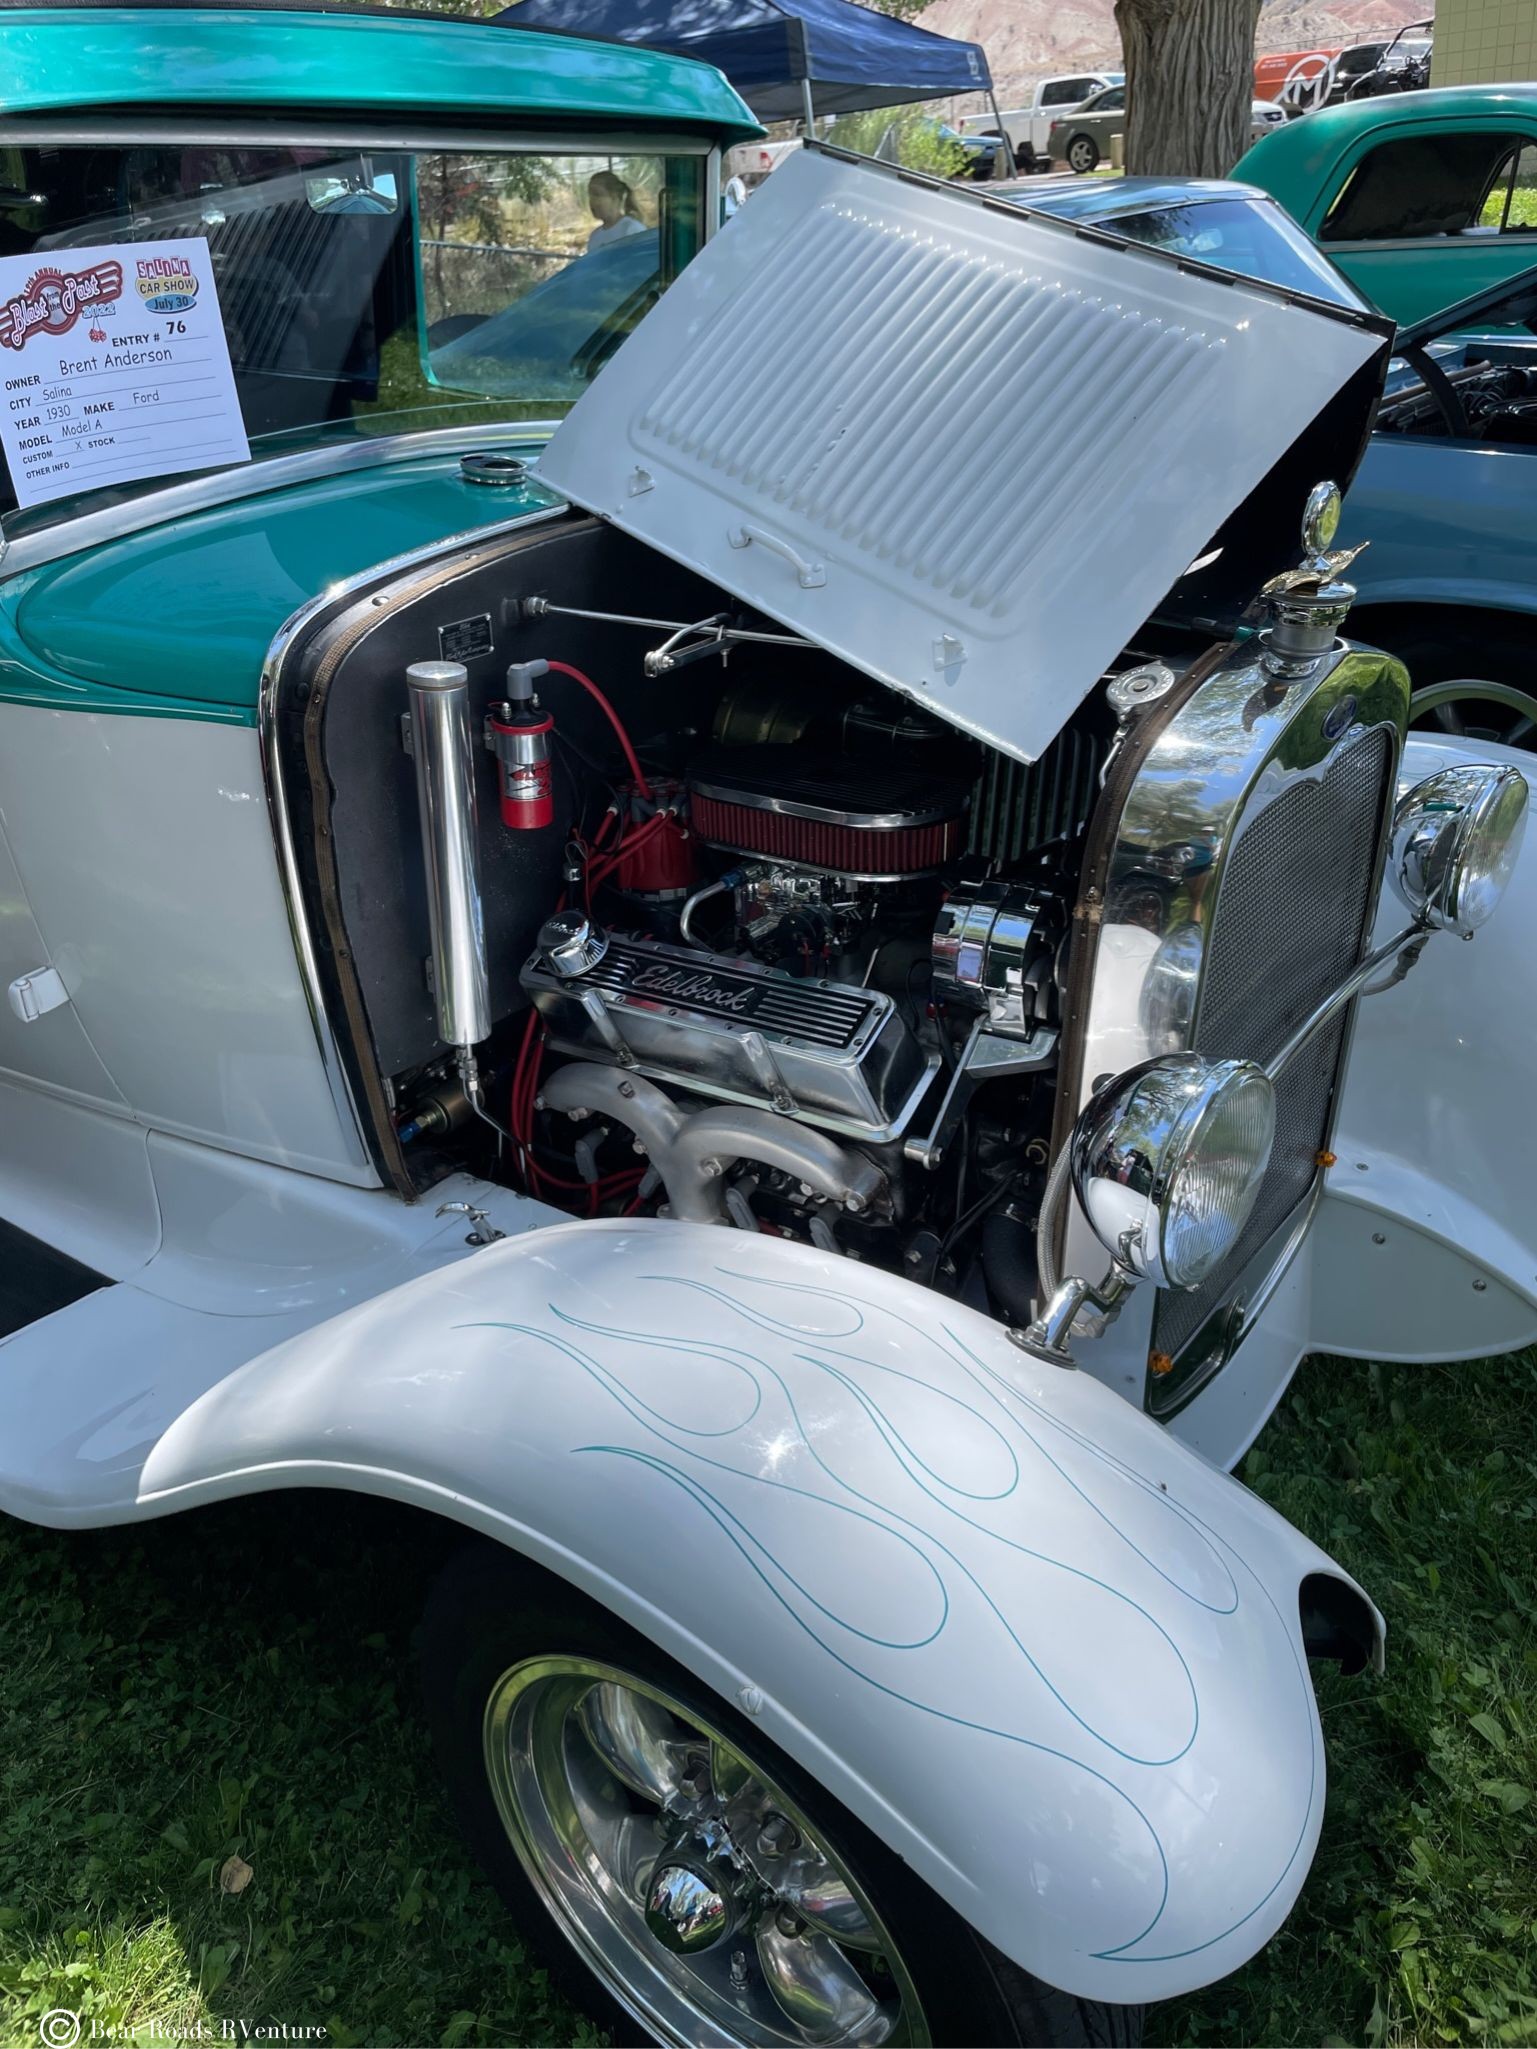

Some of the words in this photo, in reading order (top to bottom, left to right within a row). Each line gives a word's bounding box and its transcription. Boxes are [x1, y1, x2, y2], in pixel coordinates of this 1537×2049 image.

[35, 267, 62, 279] ANNUAL
[137, 258, 190, 279] SALINA
[46, 291, 60, 301] from
[62, 275, 100, 314] Past
[140, 282, 160, 294] CAR
[164, 280, 194, 292] SHOW
[49, 303, 60, 312] the
[82, 303, 116, 319] 2022
[154, 298, 173, 310] July
[176, 297, 189, 307] 30
[10, 298, 48, 346] Blast
[112, 334, 149, 347] ENTRY
[154, 333, 160, 343] #
[166, 320, 186, 335] 76
[5, 374, 41, 391] OWNER
[60, 356, 98, 376] Brent
[104, 349, 173, 368] Anderson
[9, 397, 31, 411] CITY
[42, 386, 72, 401] Salina
[14, 416, 41, 431] YEAR
[46, 405, 71, 420] 1930
[83, 402, 115, 416] MAKE
[133, 390, 160, 404] Ford
[19, 434, 53, 451] MODEL
[62, 420, 91, 437] Model
[95, 419, 103, 430] A
[22, 451, 53, 465] CUSTOM
[88, 437, 116, 449] STOCK
[26, 467, 50, 479] OTHER
[52, 462, 70, 473] INFO
[632, 965, 755, 1011] Edelbrock
